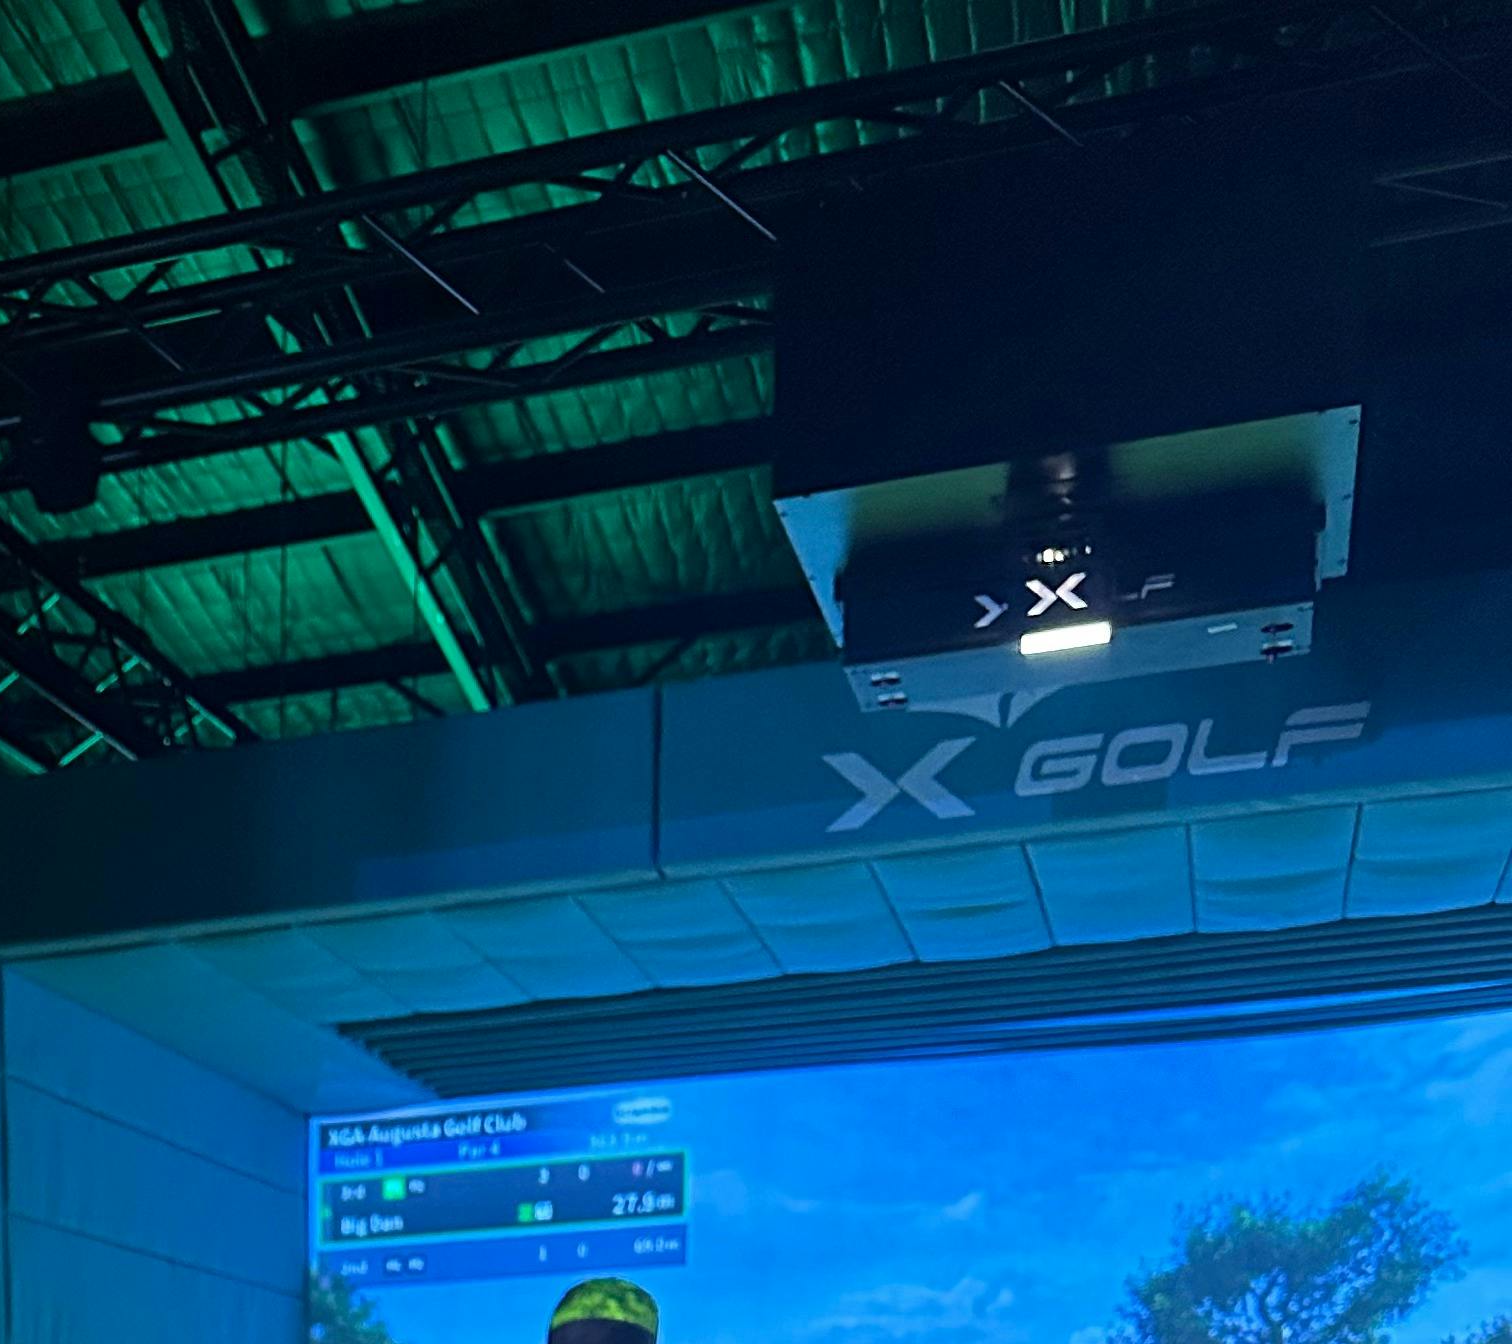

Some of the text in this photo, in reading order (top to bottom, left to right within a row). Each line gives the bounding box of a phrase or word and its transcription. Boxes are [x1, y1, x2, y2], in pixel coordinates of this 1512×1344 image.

[821, 701, 1372, 833] X GOLF
[368, 1120, 442, 1148] Augusta
[443, 1113, 482, 1138] Golf
[483, 1110, 528, 1135] Club
